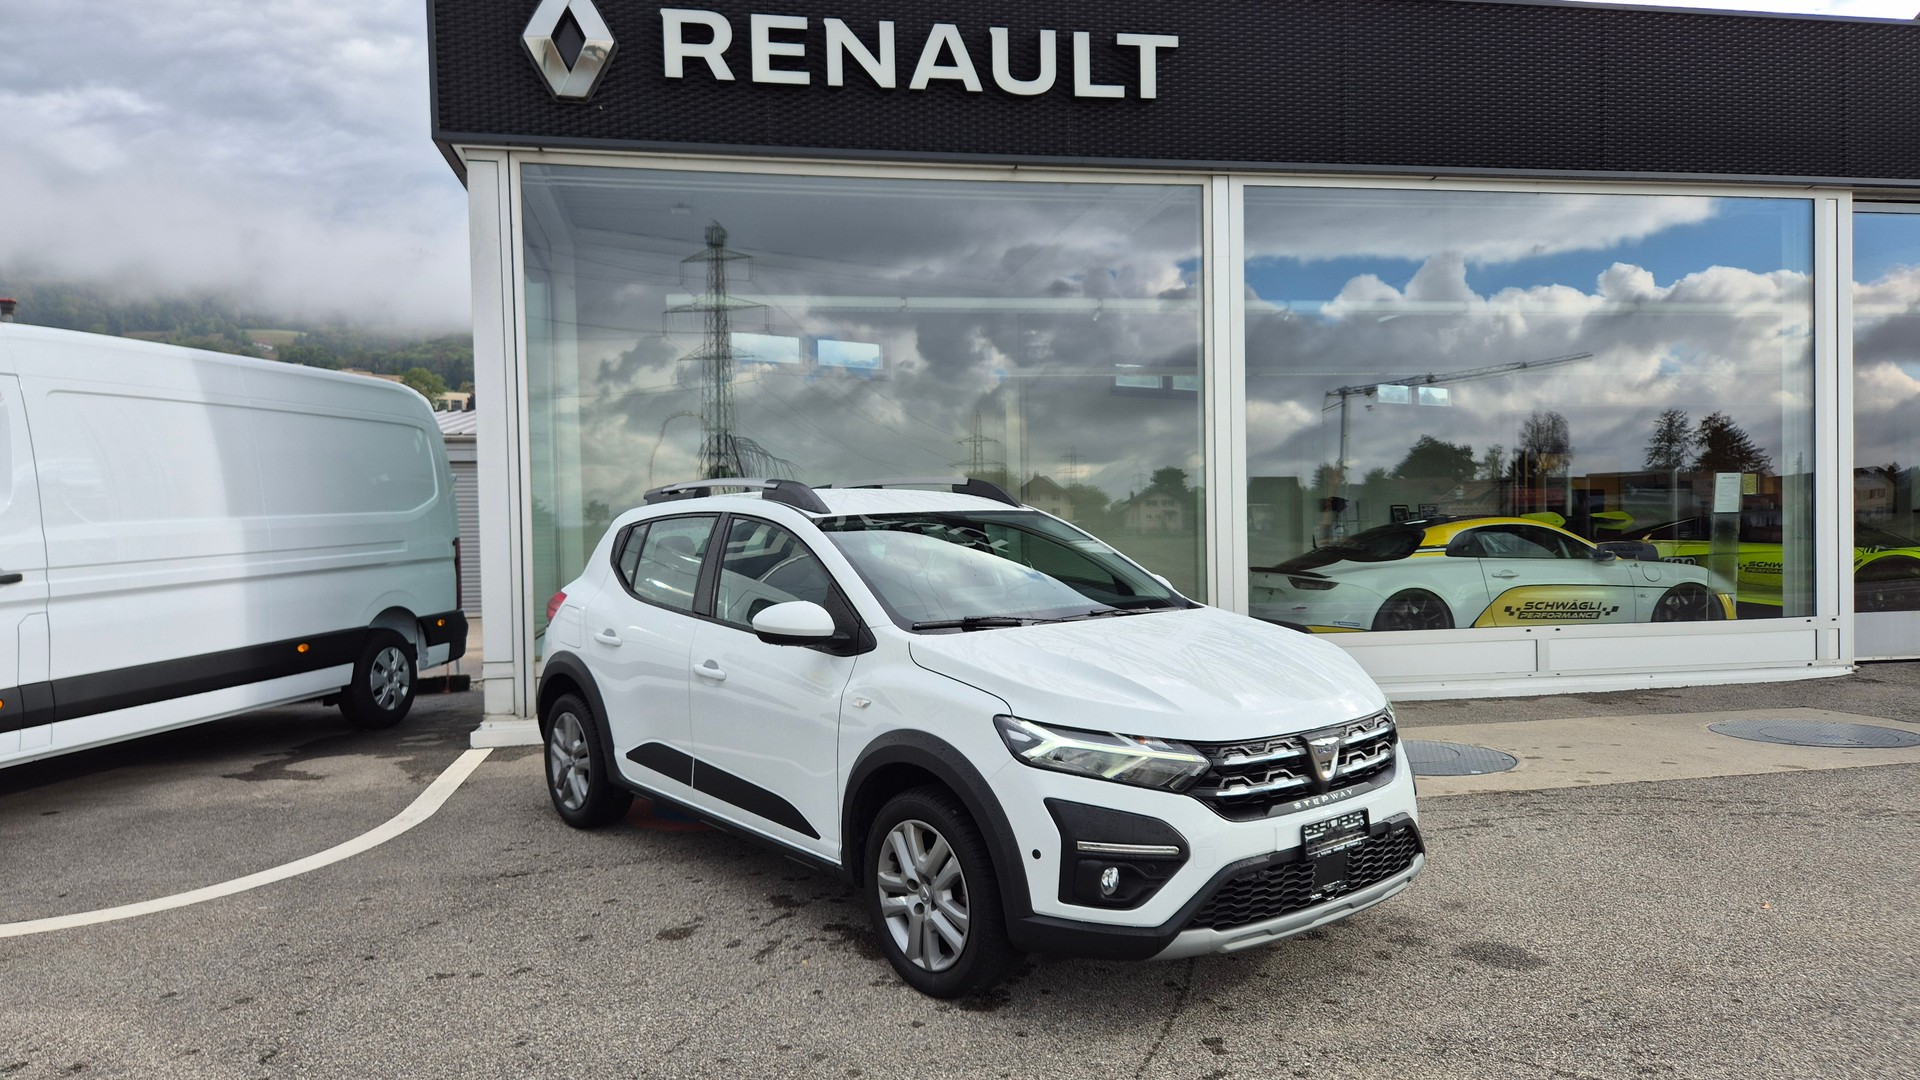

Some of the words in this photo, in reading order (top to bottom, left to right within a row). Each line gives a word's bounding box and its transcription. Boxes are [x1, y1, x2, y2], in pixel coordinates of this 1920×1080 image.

[660, 8, 1179, 99] RENAULT
[1748, 560, 1783, 568] SCHW
[1523, 600, 1602, 610] SCHWÄGLI
[1518, 611, 1600, 619] PERFORMANCE
[1293, 789, 1353, 809] STEPWAY
